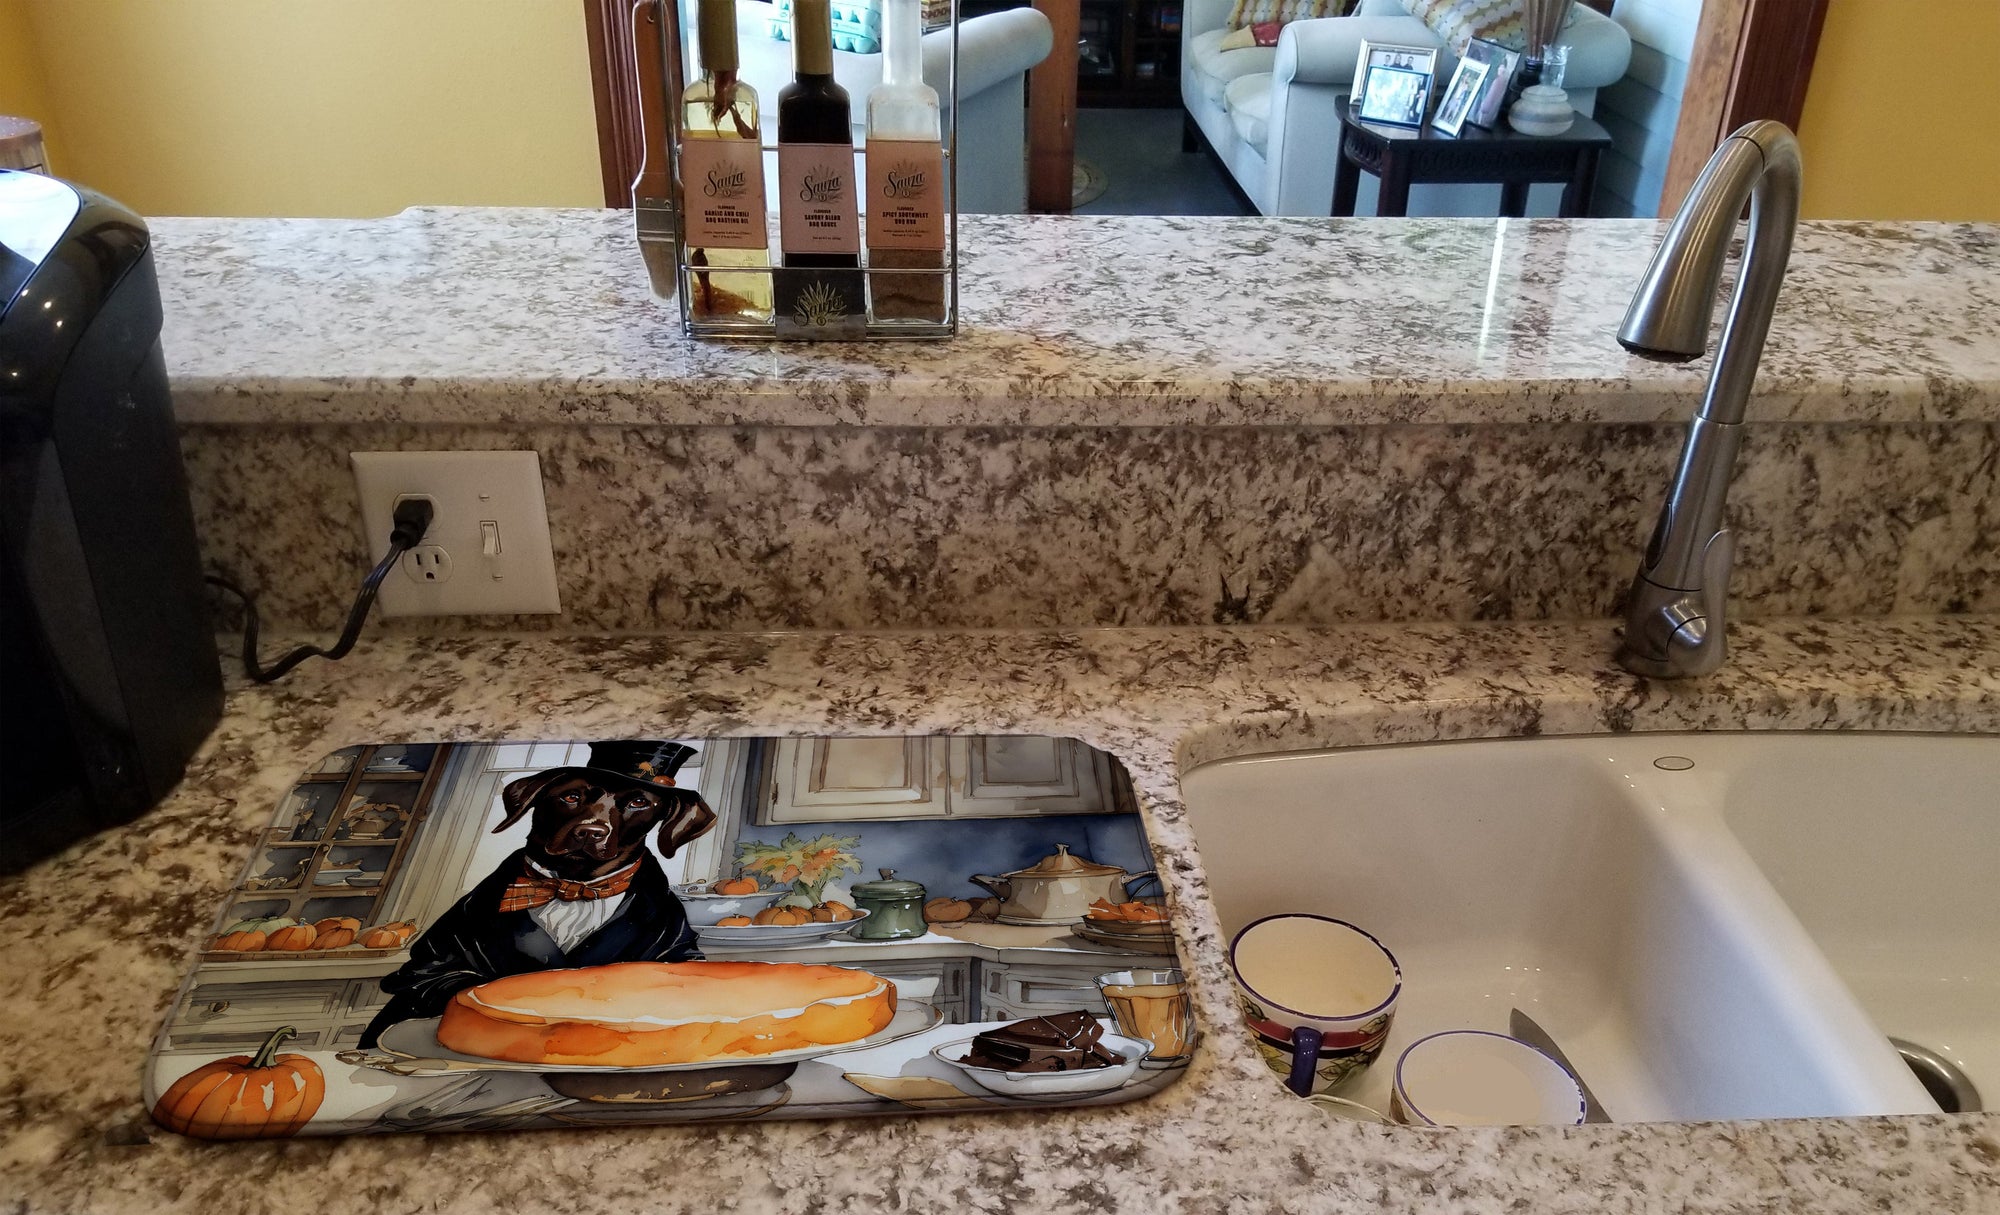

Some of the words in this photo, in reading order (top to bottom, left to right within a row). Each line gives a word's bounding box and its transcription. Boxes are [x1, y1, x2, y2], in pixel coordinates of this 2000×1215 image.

[703, 169, 746, 197] Sauza
[800, 175, 842, 202] Sauza
[883, 170, 925, 198] Sauza
[898, 211, 929, 219] SOUTHWEST
[792, 294, 844, 327] Sauza
